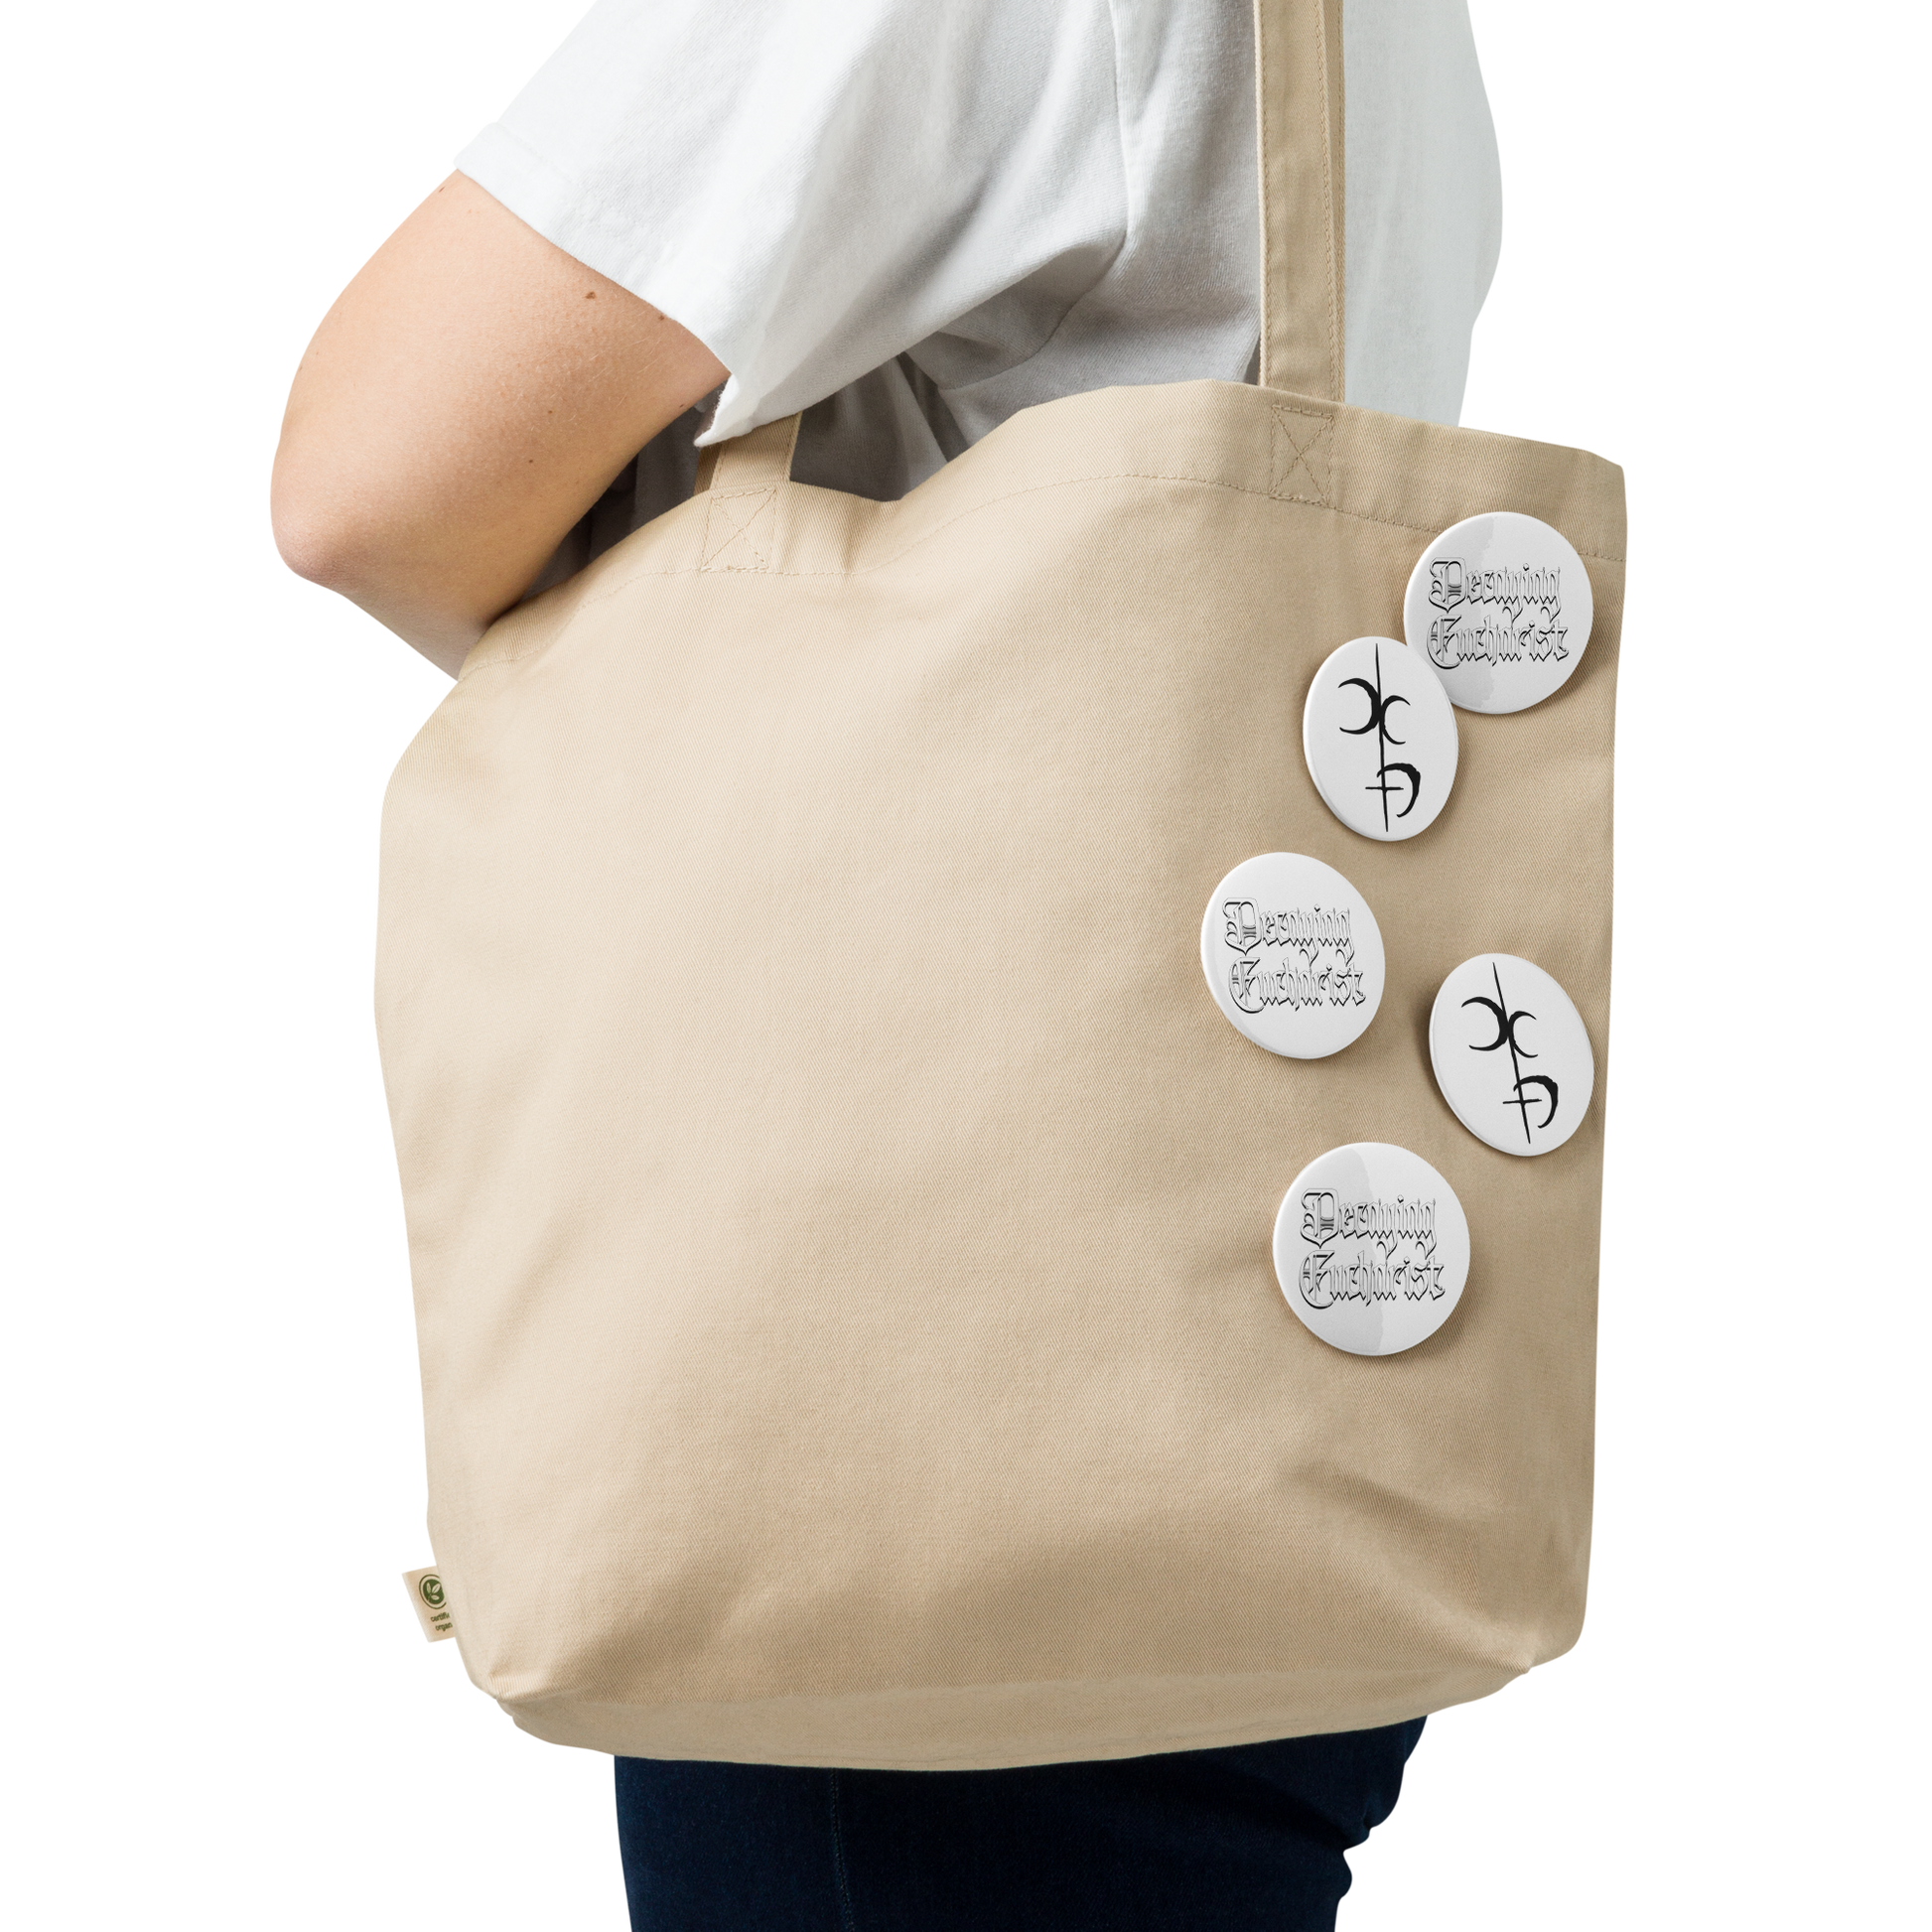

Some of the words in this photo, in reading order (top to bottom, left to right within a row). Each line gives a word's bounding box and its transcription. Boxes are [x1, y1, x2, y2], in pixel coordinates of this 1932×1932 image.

[1428, 557, 1562, 623] Decaying
[1222, 897, 1355, 967] Decaying
[1300, 1187, 1438, 1260] Decaying
